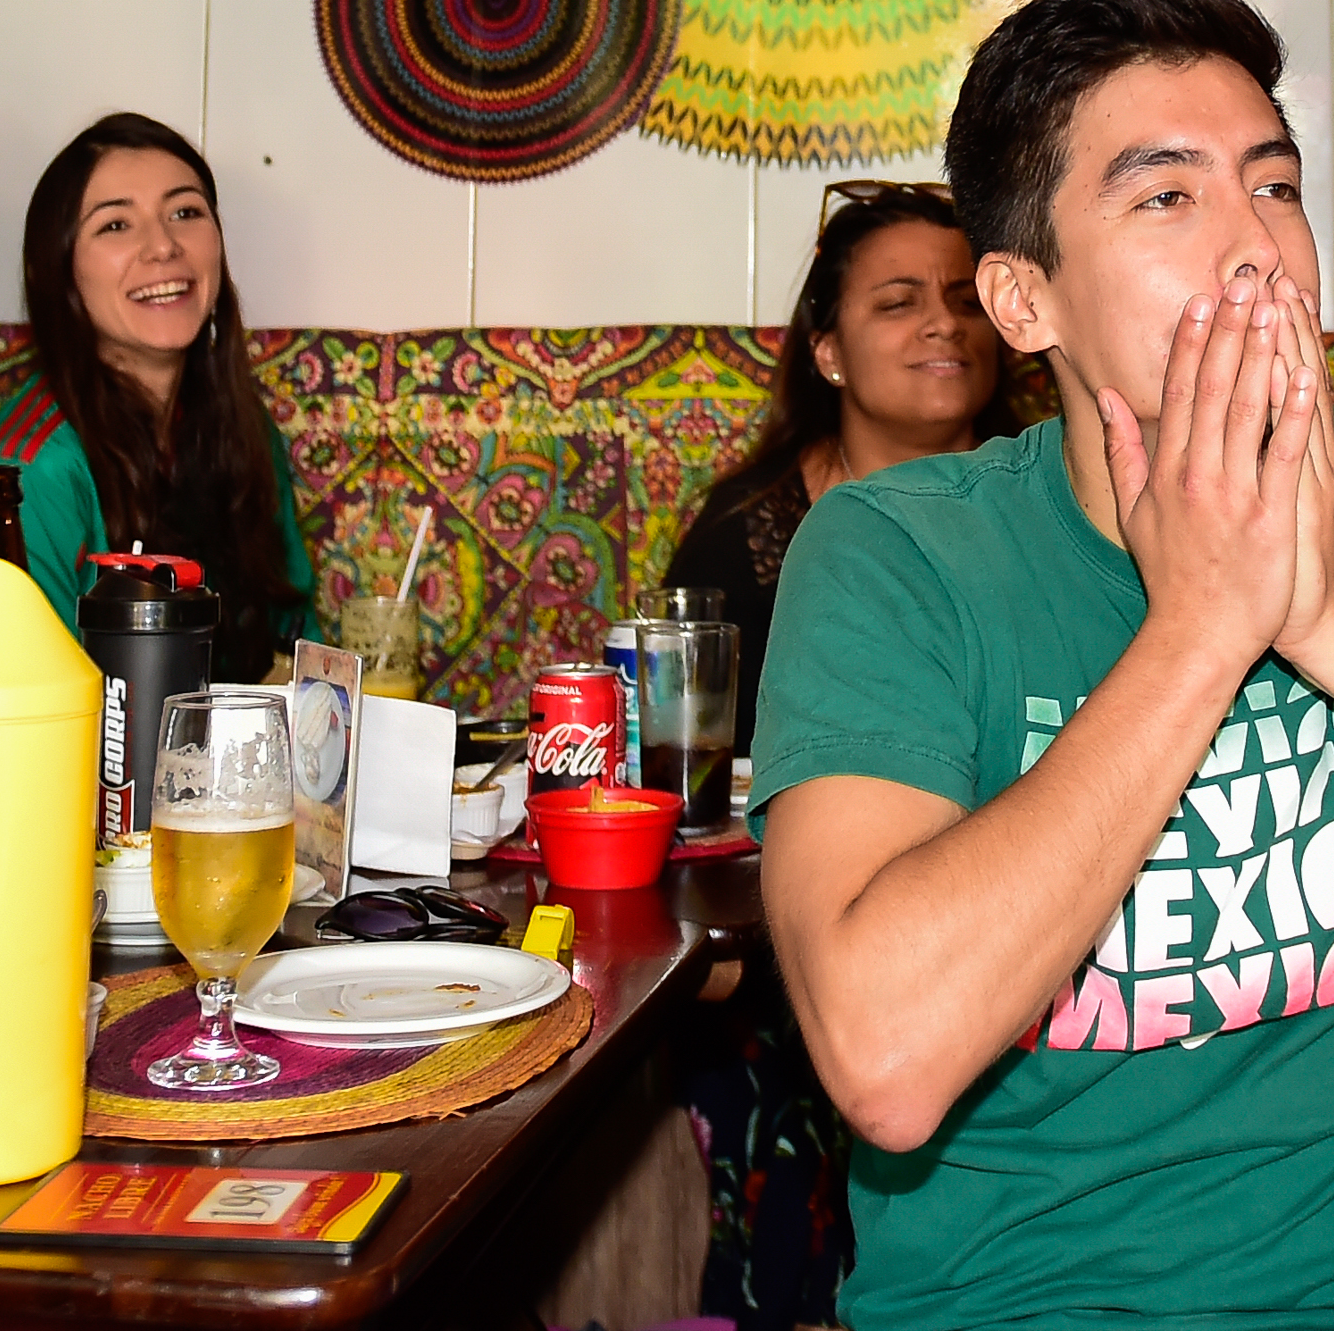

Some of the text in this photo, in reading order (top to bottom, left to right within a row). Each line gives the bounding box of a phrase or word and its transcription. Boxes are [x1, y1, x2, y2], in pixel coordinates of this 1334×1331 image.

[104, 674, 127, 786] CORPS
[67, 1174, 122, 1220] NACHO
[103, 1176, 158, 1219] LIBRE
[210, 1185, 286, 1218] 198
